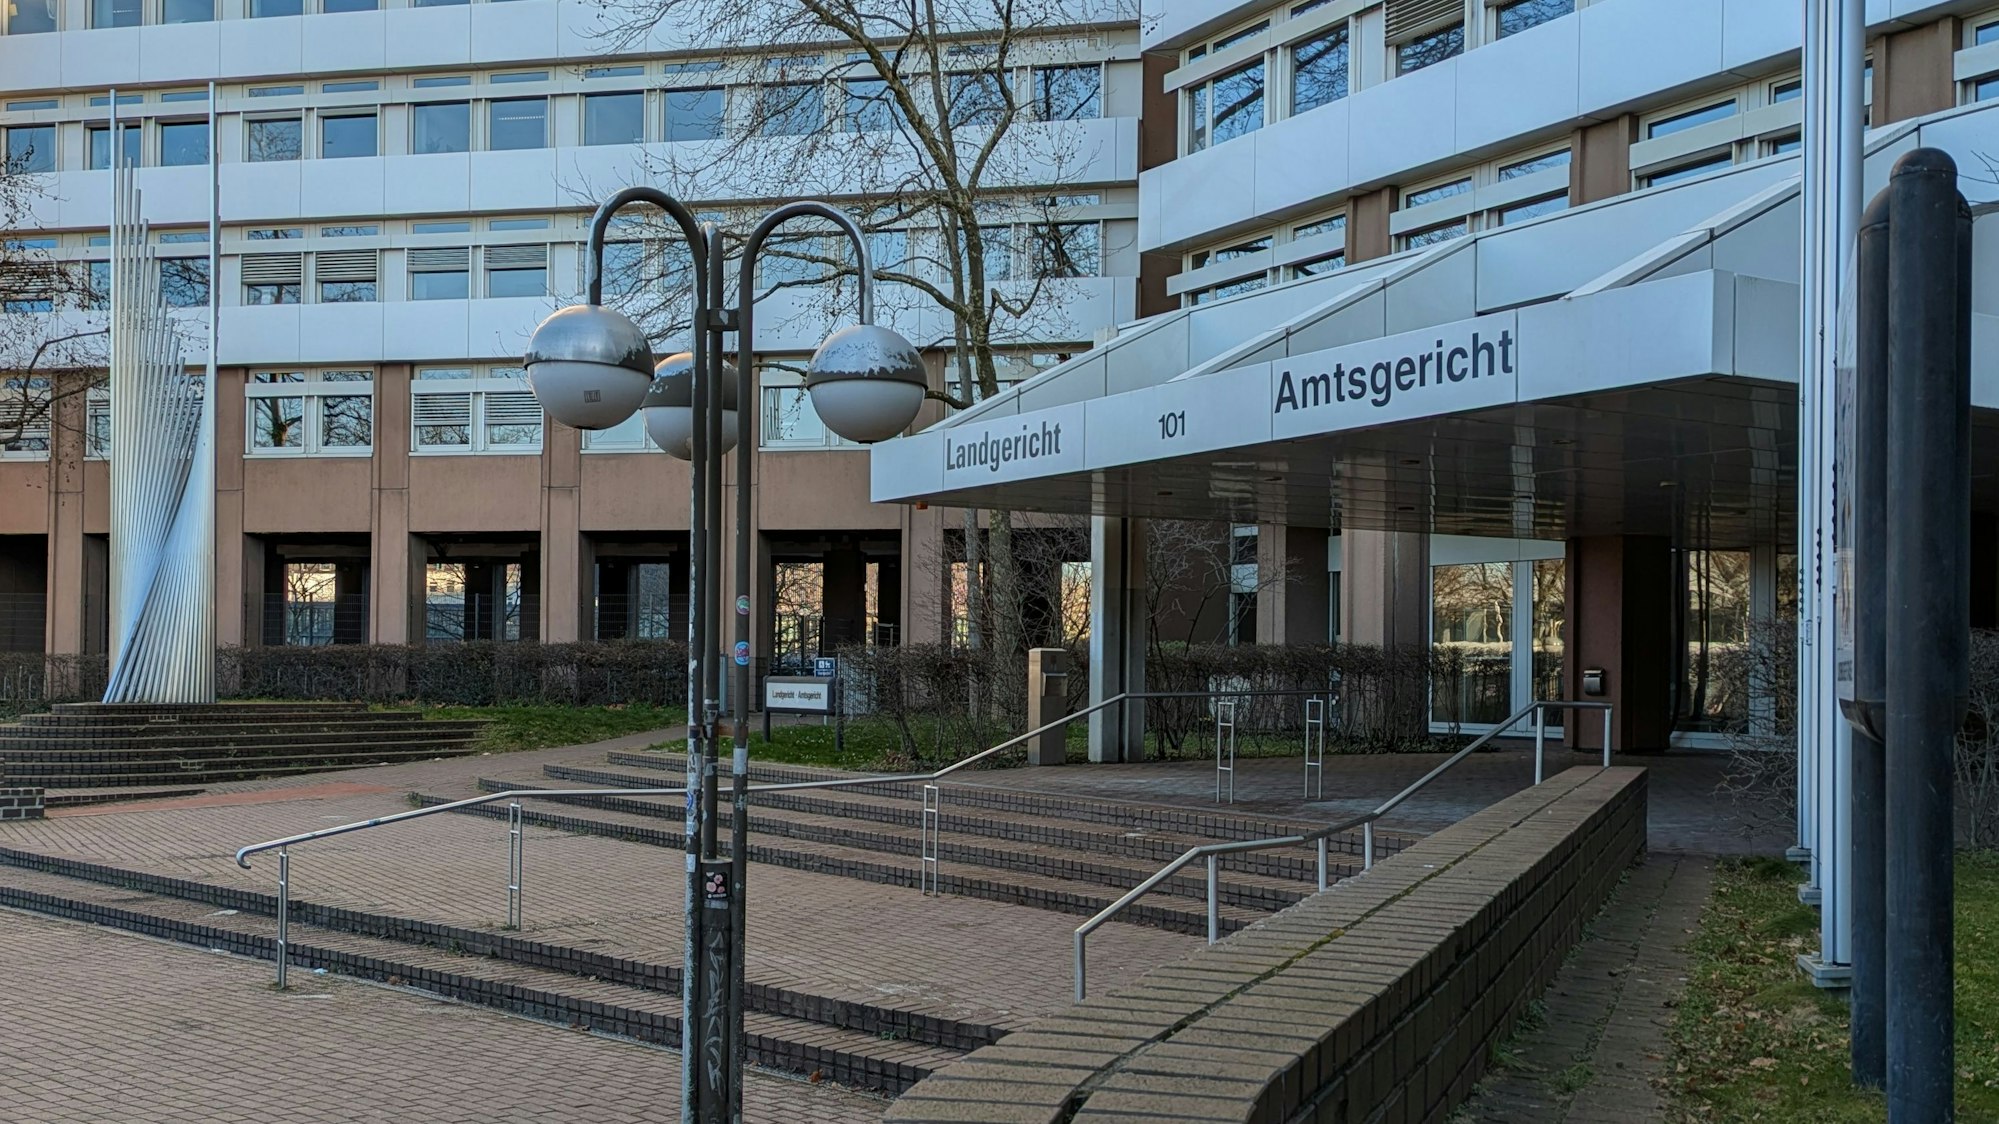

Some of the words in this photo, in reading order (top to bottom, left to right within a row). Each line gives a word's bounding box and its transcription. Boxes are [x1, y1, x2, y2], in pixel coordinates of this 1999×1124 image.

[1274, 330, 1513, 413] Amtsgericht
[946, 421, 1062, 472] Landgericht
[1158, 410, 1185, 440] 101
